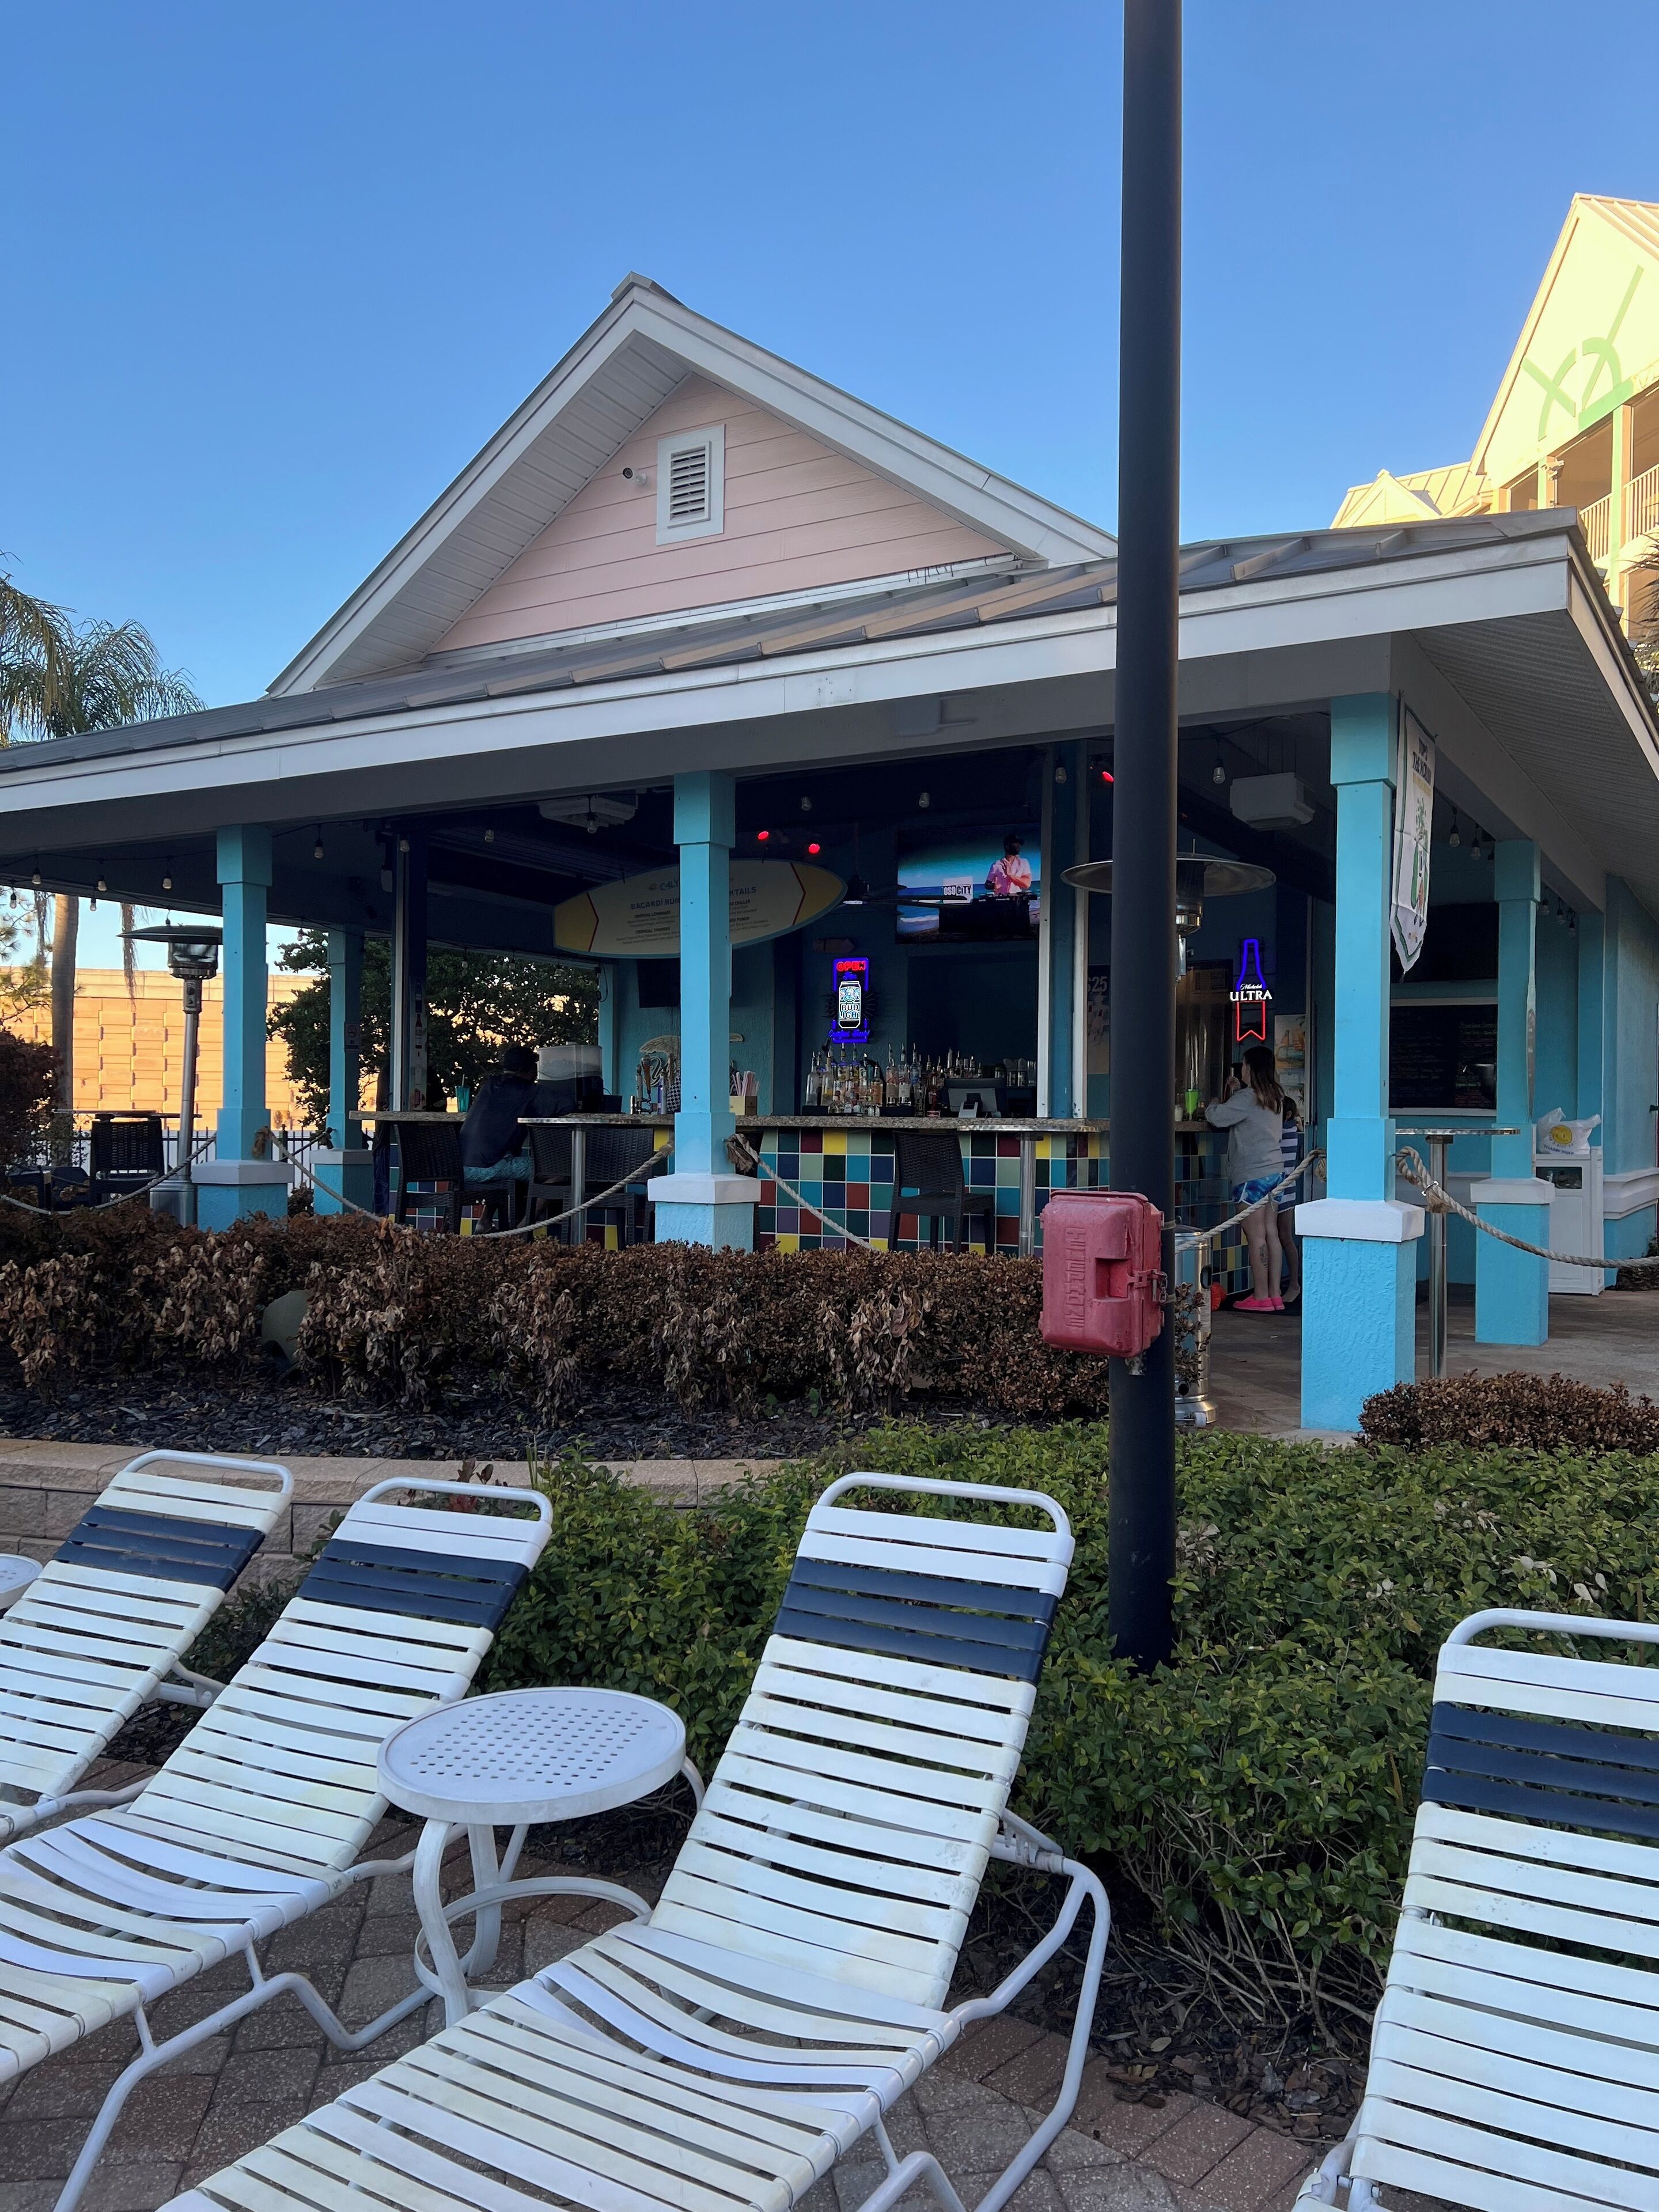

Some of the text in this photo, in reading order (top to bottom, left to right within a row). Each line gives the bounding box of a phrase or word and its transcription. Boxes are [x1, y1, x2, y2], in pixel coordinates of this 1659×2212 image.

[661, 878, 679, 890] CALY
[729, 887, 756, 896] KTAILS
[836, 961, 866, 971] OPEN
[1230, 990, 1272, 1001] ULTRA
[839, 1011, 859, 1019] LIGHT
